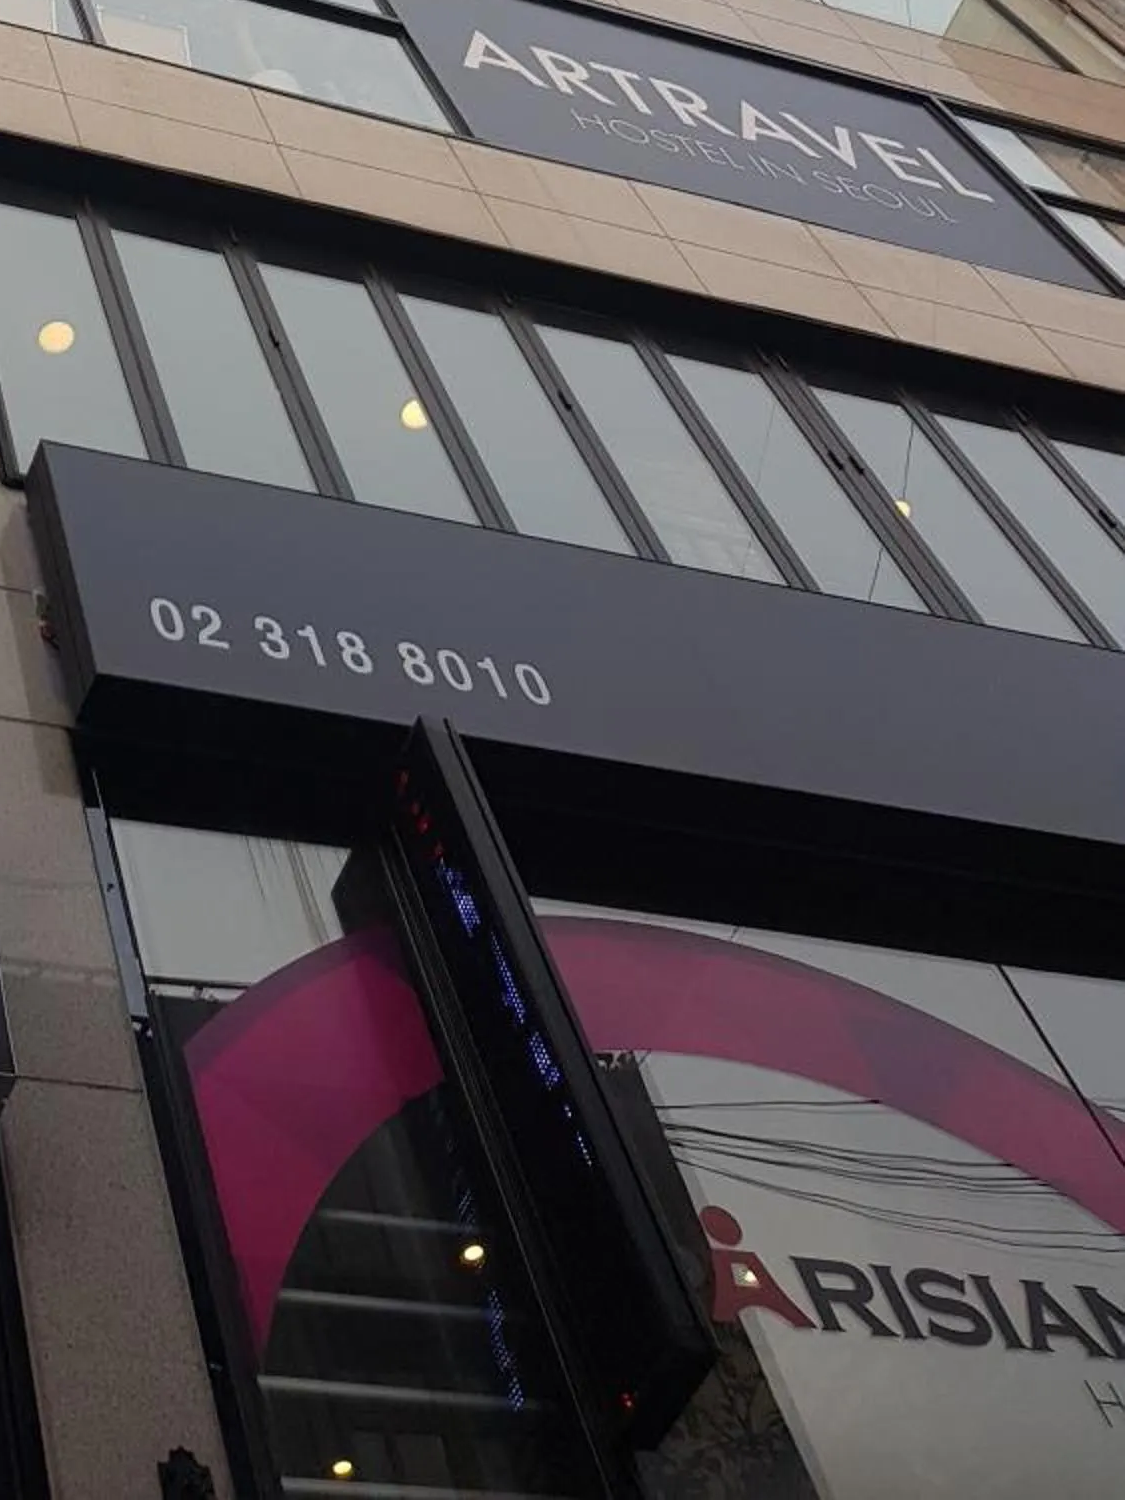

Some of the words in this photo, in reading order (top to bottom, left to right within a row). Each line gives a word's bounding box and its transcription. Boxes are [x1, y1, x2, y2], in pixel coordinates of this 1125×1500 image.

[463, 28, 995, 203] ARTRAVEL
[571, 107, 745, 172] HOSTEL
[747, 152, 808, 186] IN
[812, 169, 960, 224] SEOUL
[149, 597, 230, 650] 02
[254, 616, 374, 676] 318
[397, 642, 552, 706] 8010
